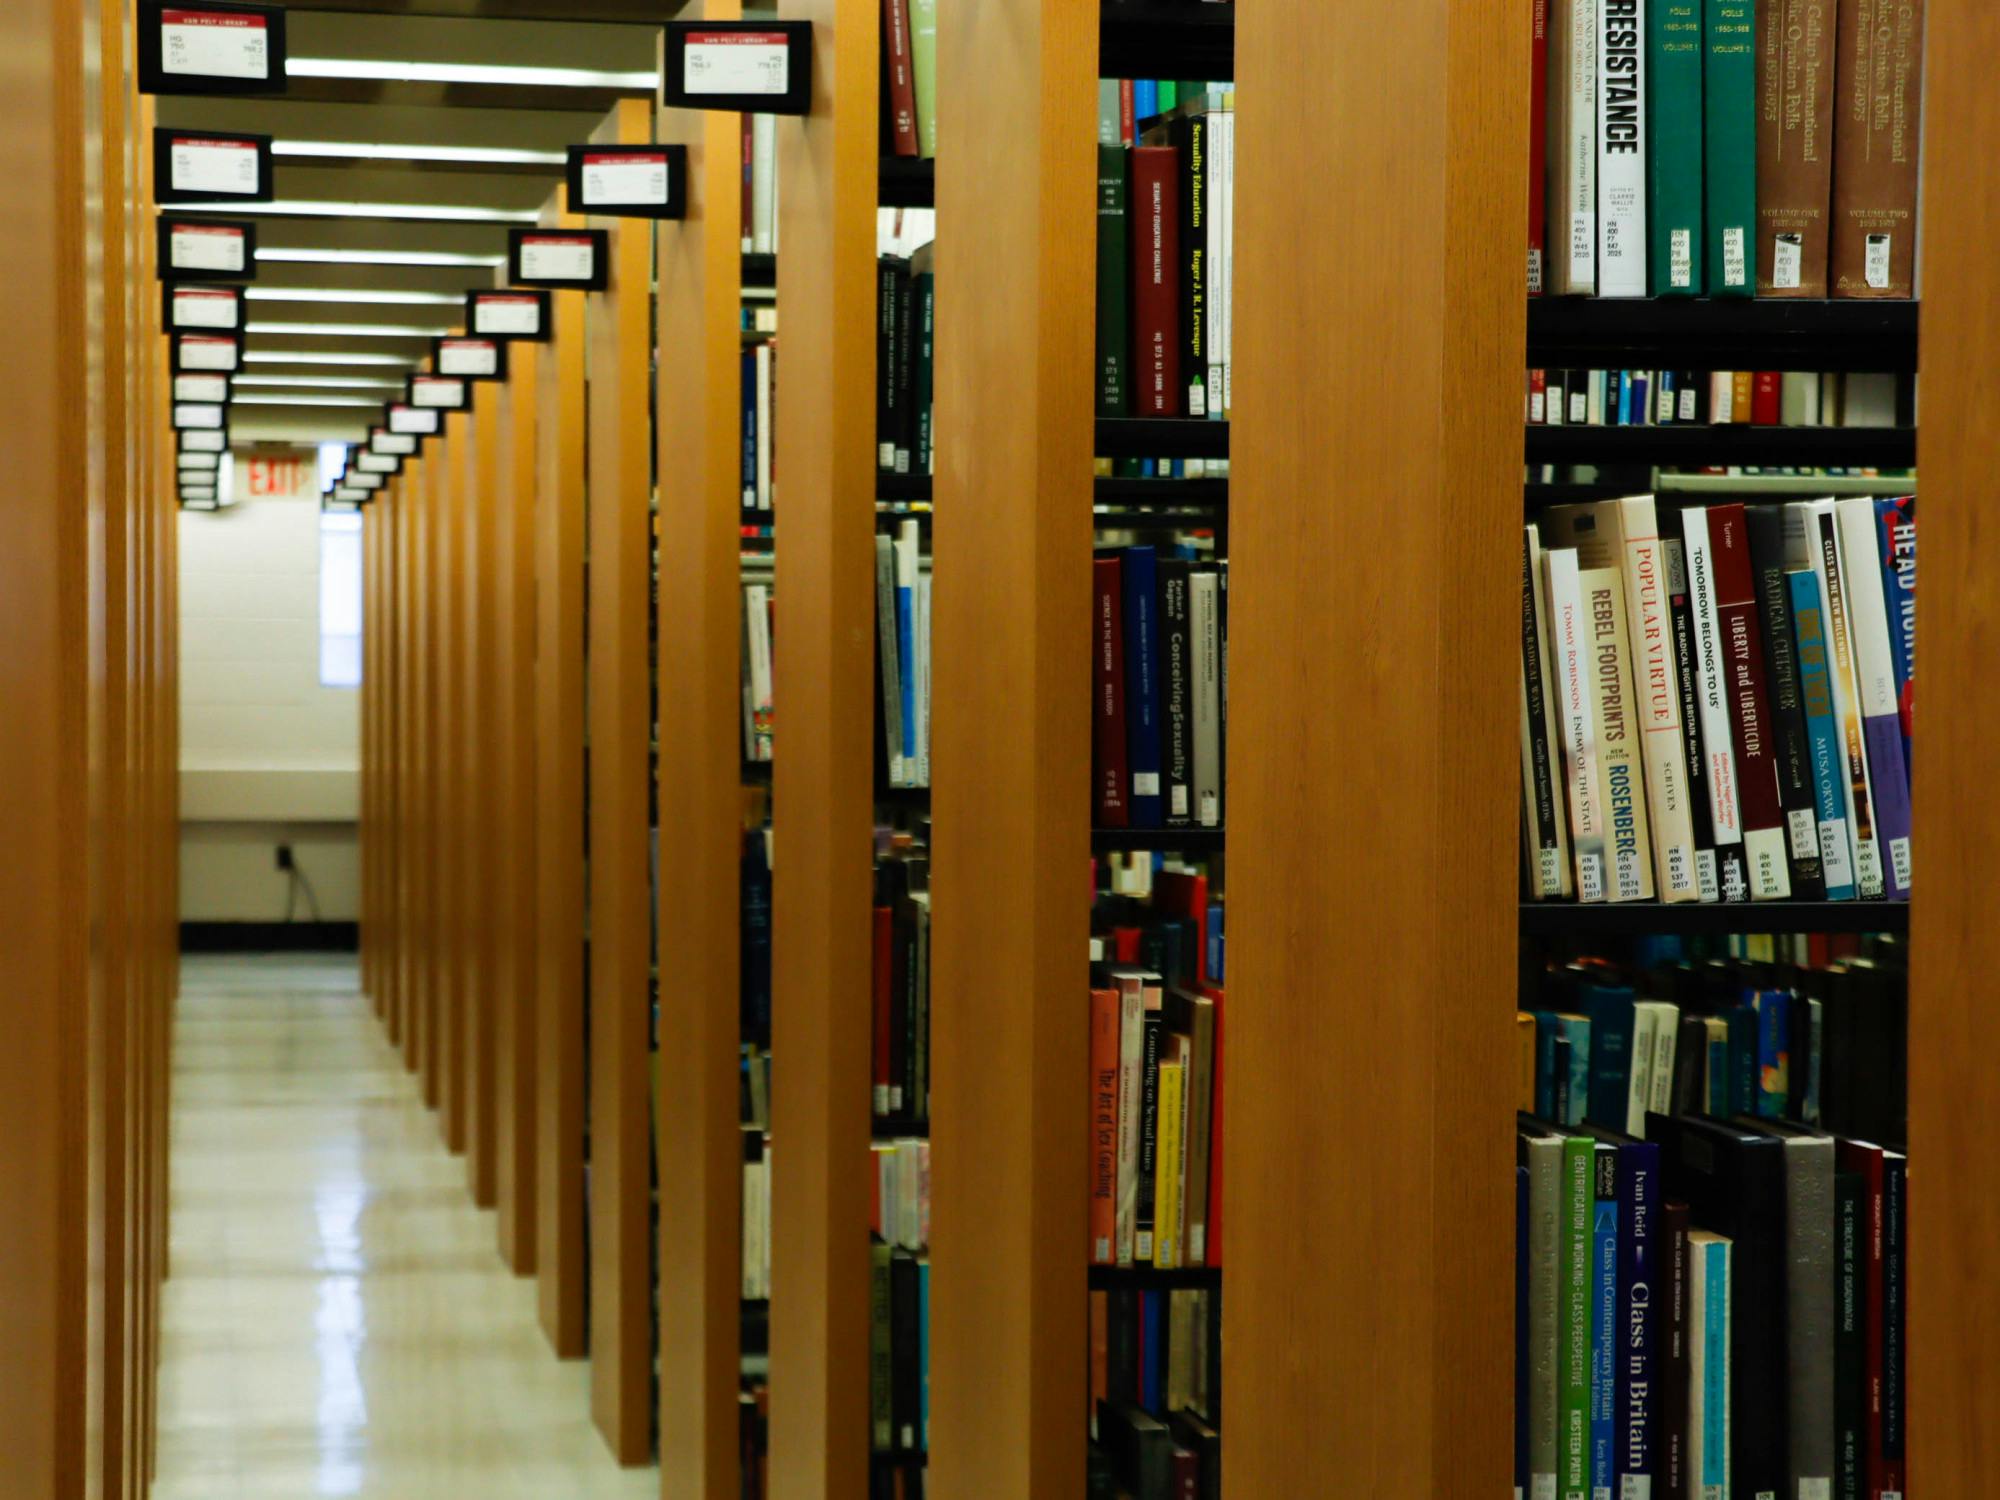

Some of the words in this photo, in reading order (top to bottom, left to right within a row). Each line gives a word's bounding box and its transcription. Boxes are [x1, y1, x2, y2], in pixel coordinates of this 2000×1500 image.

[1669, 7, 1692, 16] POLLS
[1720, 9, 1744, 17] POLLS
[1662, 43, 1693, 52] VOLUME
[1804, 4, 1822, 58] Gallup
[1893, 5, 1912, 59] Gallup
[1584, 41, 1594, 70] SPACE
[1712, 45, 1744, 54] VOLUME
[1784, 24, 1803, 89] Opinion
[1873, 25, 1892, 91] Opinion
[1584, 74, 1594, 84] IN
[1605, 0, 1637, 155] RESISTANCE
[1763, 59, 1779, 122] 1937-1975
[1584, 86, 1594, 104] THE
[1785, 93, 1801, 131] Polls
[1803, 60, 1821, 163] International
[1873, 94, 1890, 131] Polls
[1891, 61, 1911, 164] International
[1190, 123, 1202, 173] Sexuality
[1578, 135, 1591, 181] Katherine
[1152, 182, 1162, 214] SEXUALITY
[1192, 174, 1202, 228] Education
[1763, 208, 1798, 218] VOLUME
[1849, 209, 1887, 219] VOLUME
[1888, 209, 1909, 219] TWO
[1153, 215, 1162, 249] EDUCATION
[1153, 250, 1162, 285] CHALLENGE
[1191, 249, 1203, 283] Roger
[1191, 309, 1202, 358] Levesque
[248, 457, 303, 496] EXIT
[1723, 521, 1734, 549] Turner
[1670, 548, 1686, 588] palgrave
[1823, 539, 1834, 566] CLASS
[1893, 523, 1917, 593] HEAD
[1827, 568, 1836, 578] IN
[1828, 580, 1838, 595] THE
[1636, 546, 1662, 641] POPULAR
[1764, 568, 1788, 635] RADICAL
[1830, 597, 1840, 615] NEW
[1563, 603, 1576, 647] TOMMY
[1592, 589, 1616, 642] REBEL
[1676, 615, 1686, 631] THE
[1678, 631, 1690, 667] RADICAL
[1699, 621, 1716, 673] BELONGS
[1730, 616, 1749, 661] LIBERTY
[1832, 618, 1848, 669] MILLENNIUM
[1566, 650, 1581, 711] ROBINSON
[1647, 643, 1670, 722] VIRTUE
[1681, 667, 1693, 693] RIGHT
[1705, 674, 1717, 690] TO
[1735, 665, 1753, 687] and
[1773, 639, 1798, 711] CULTURE
[1597, 644, 1626, 743] FOOTPRINTS
[1684, 693, 1694, 703] IN
[1573, 715, 1585, 755] ENEMY
[1686, 704, 1697, 737] BRITAIN
[1739, 690, 1762, 759] LIBERTICIDE
[1689, 739, 1698, 755] Alan
[1720, 752, 1730, 775] Edited
[1815, 736, 1831, 777] MUSA
[1577, 757, 1588, 773] OF
[1690, 756, 1700, 777] Sykes
[1579, 775, 1590, 799] THE
[1662, 760, 1677, 812] SCRIVEN
[1714, 768, 1724, 798] Matthew
[1581, 800, 1593, 834] STATE
[1823, 834, 1835, 842] 400
[1669, 856, 1683, 864] 400
[1859, 853, 1873, 861] 400
[1672, 881, 1689, 889] 2017
[1099, 1068, 1116, 1089] The
[1098, 1092, 1115, 1110] Art
[1097, 1113, 1114, 1125] of
[1097, 1128, 1114, 1147] Sex
[1095, 1150, 1114, 1200] Coaching
[1603, 1155, 1616, 1196] palgrave
[1634, 1170, 1647, 1201] Ivan
[1634, 1205, 1647, 1238] Reid
[1844, 1199, 1855, 1214] THE
[1603, 1237, 1616, 1270] Class
[1843, 1216, 1855, 1261] STRUCTURE
[1571, 1242, 1586, 1324] WORKING-CLASS
[1603, 1272, 1616, 1285] in
[1844, 1262, 1855, 1273] OF
[1630, 1281, 1650, 1348] Class
[1843, 1275, 1855, 1333] DISADVANTAGE
[1599, 1286, 1616, 1377] Contemporary
[1570, 1325, 1584, 1388] PERSPECTIVE
[1591, 1348, 1601, 1384] Second
[1630, 1355, 1647, 1375] in
[1590, 1386, 1600, 1421] Edition
[1601, 1378, 1614, 1421] Britain
[1570, 1409, 1582, 1454] KIRSTEEN
[1629, 1381, 1648, 1469] Britain
[1596, 1439, 1607, 1459] Ken
[1569, 1456, 1581, 1487] PATON
